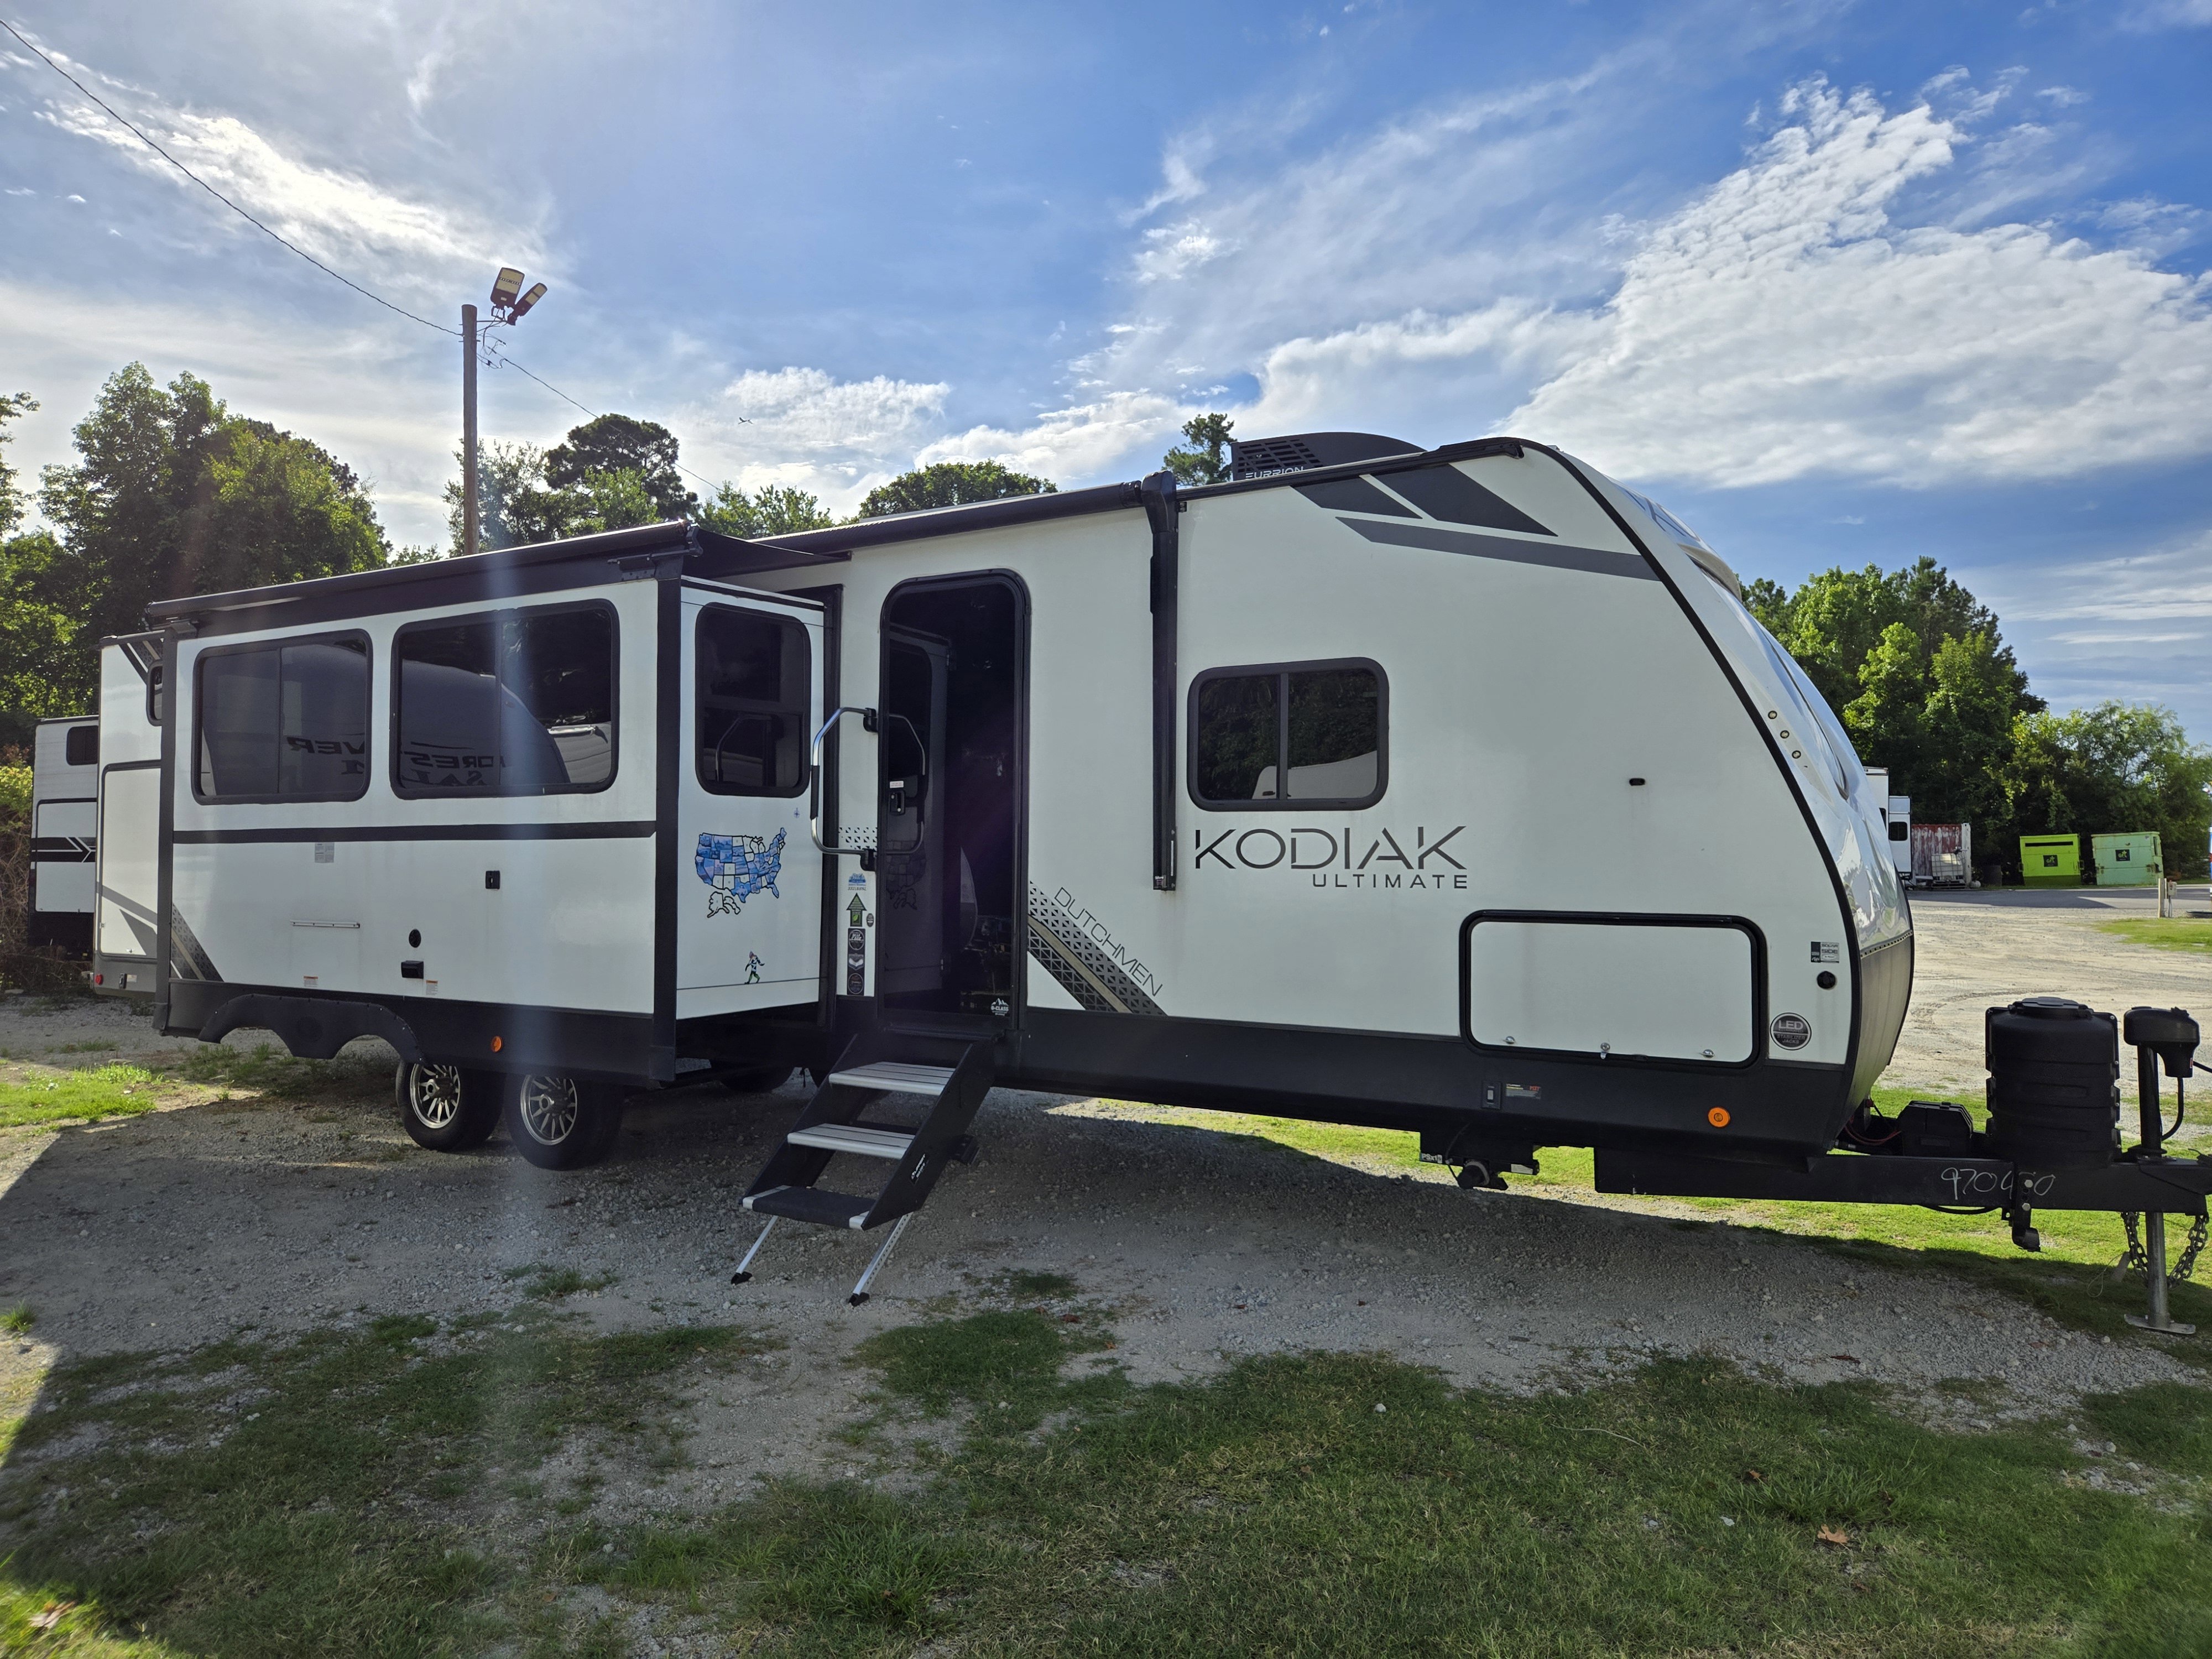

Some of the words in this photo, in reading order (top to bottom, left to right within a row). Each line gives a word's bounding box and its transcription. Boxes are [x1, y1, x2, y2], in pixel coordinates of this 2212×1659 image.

[1245, 466, 1304, 479] FURRION
[1196, 826, 1468, 870] KODIAK
[1312, 874, 1468, 889] ULTIMATE
[1054, 886, 1163, 997] DUTCHMEN
[1778, 1020, 1804, 1030] LED
